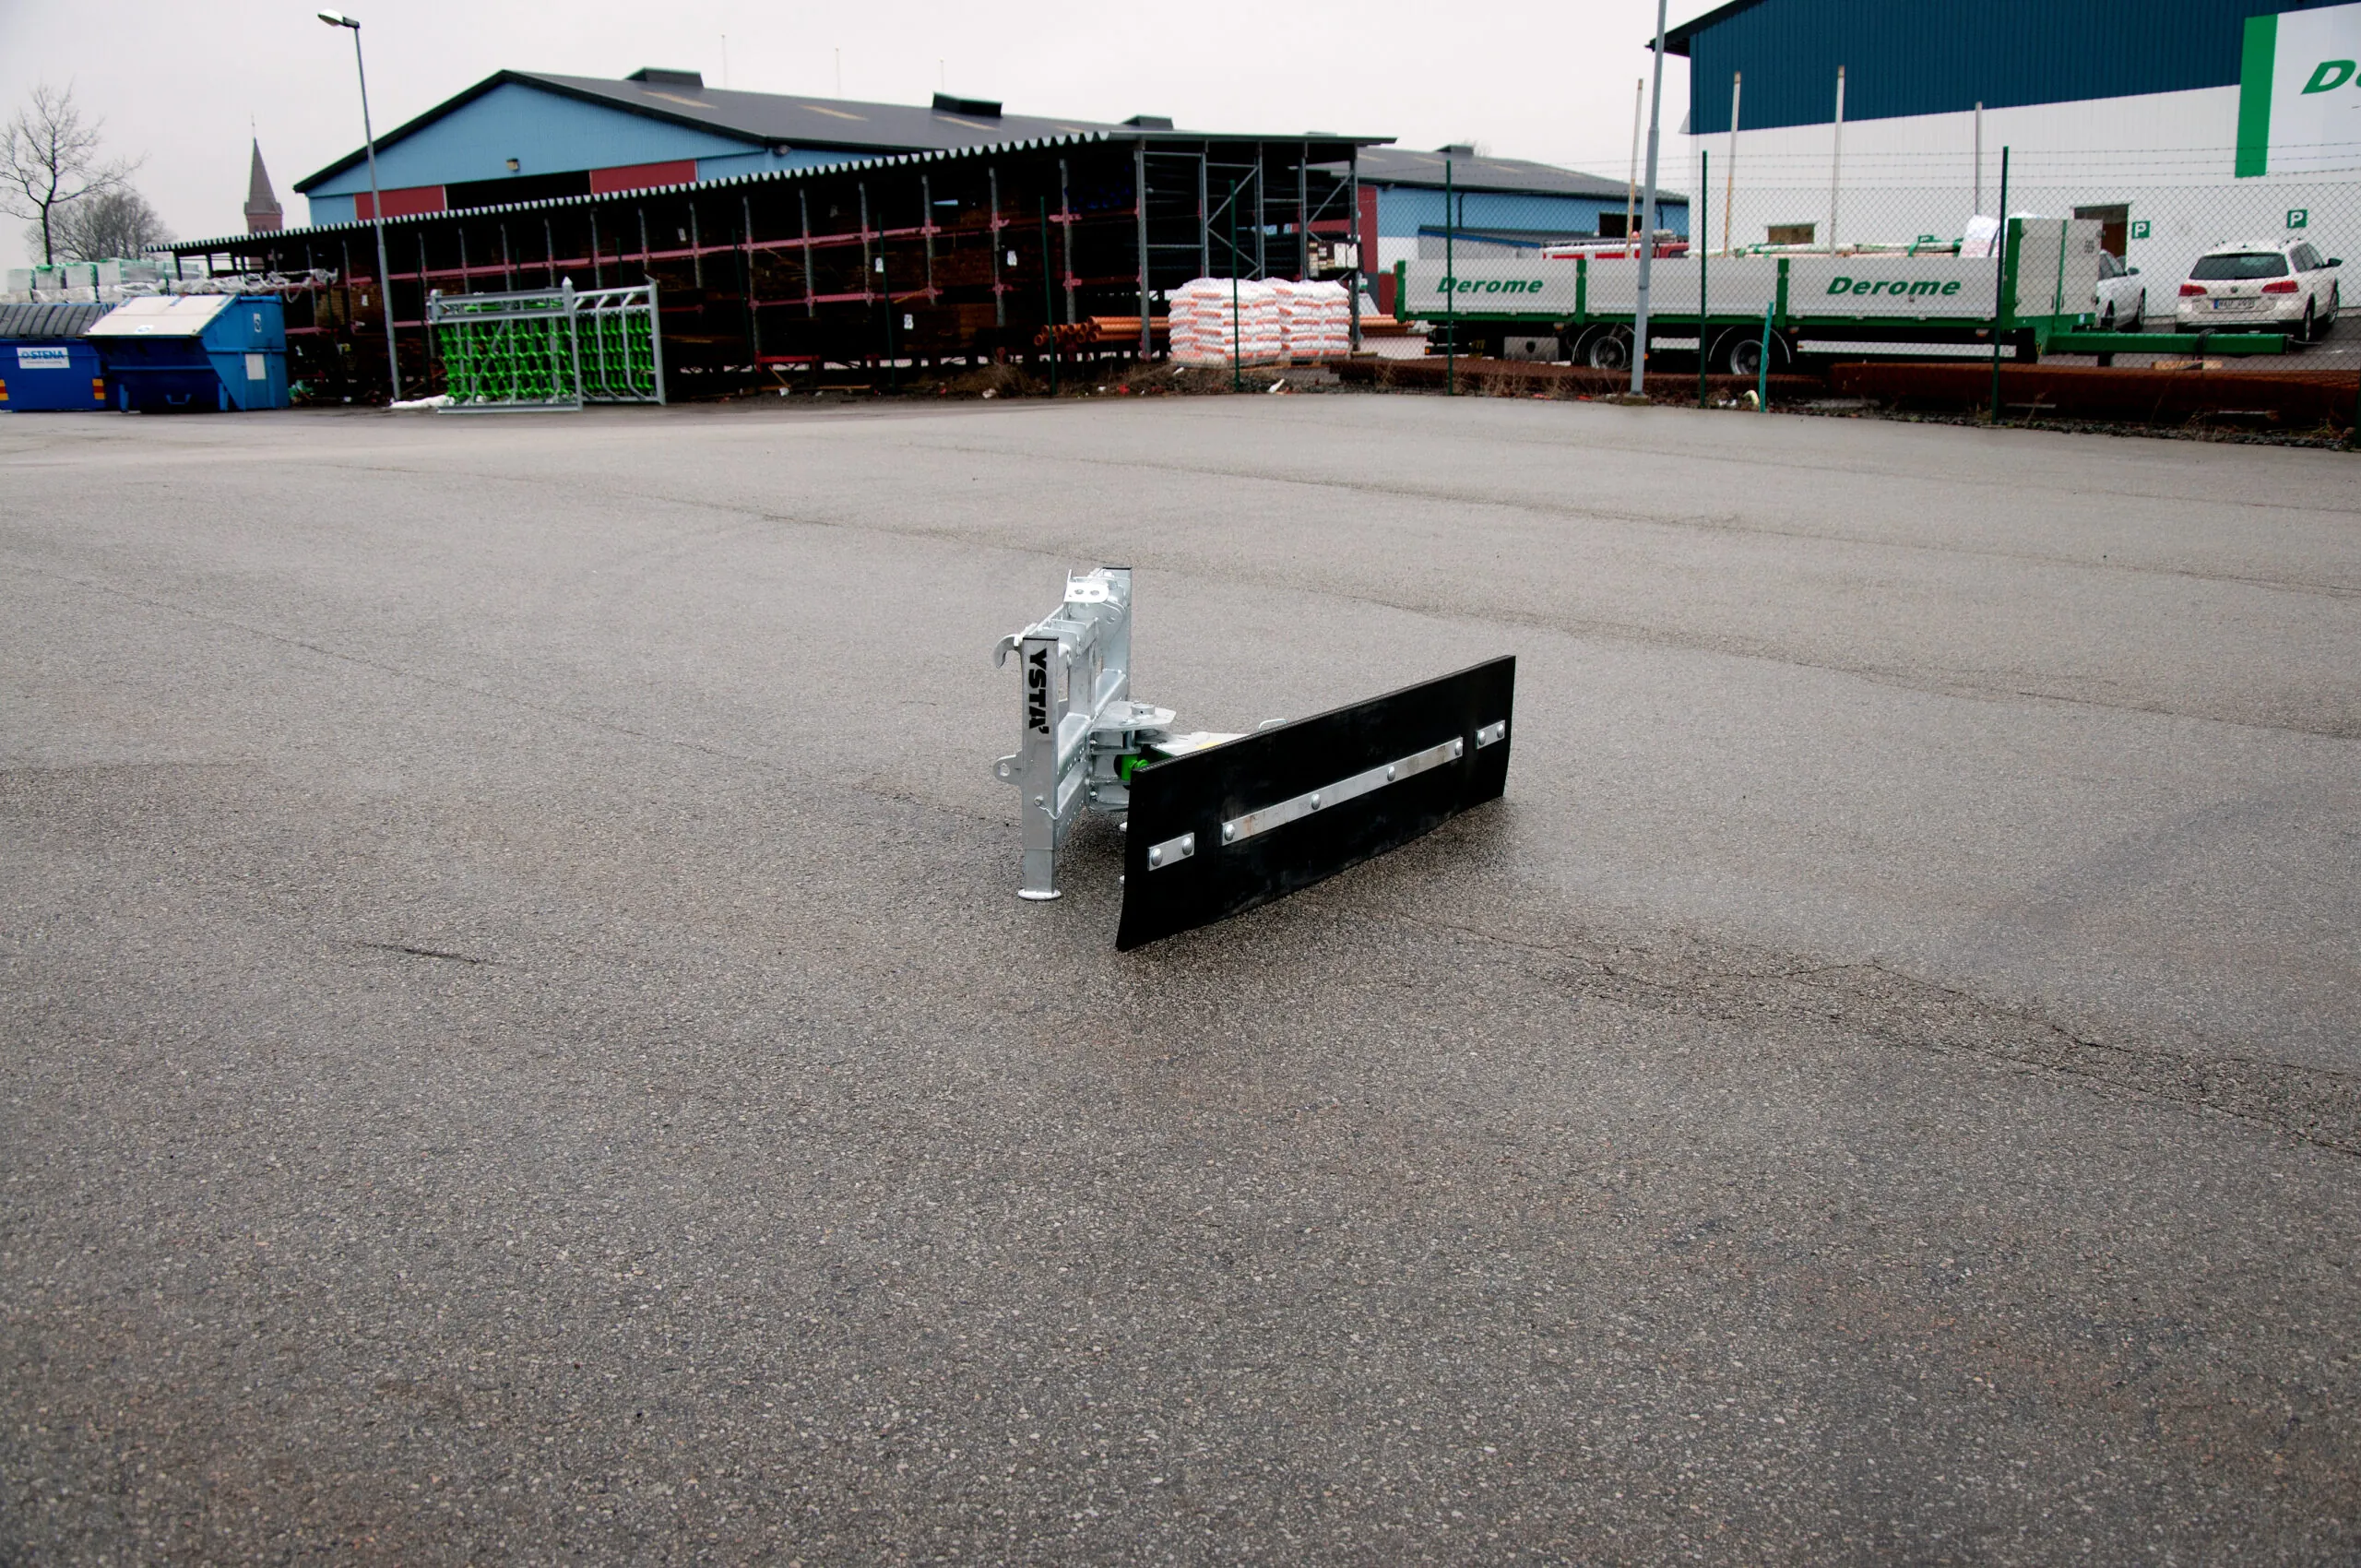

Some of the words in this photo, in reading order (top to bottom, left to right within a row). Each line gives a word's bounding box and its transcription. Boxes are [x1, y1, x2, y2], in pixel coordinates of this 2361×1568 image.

[2300, 59, 2361, 95] D
[2291, 211, 2304, 227] P
[2135, 222, 2147, 237] P
[1437, 276, 1544, 293] Derome
[1826, 276, 1961, 295] Derome
